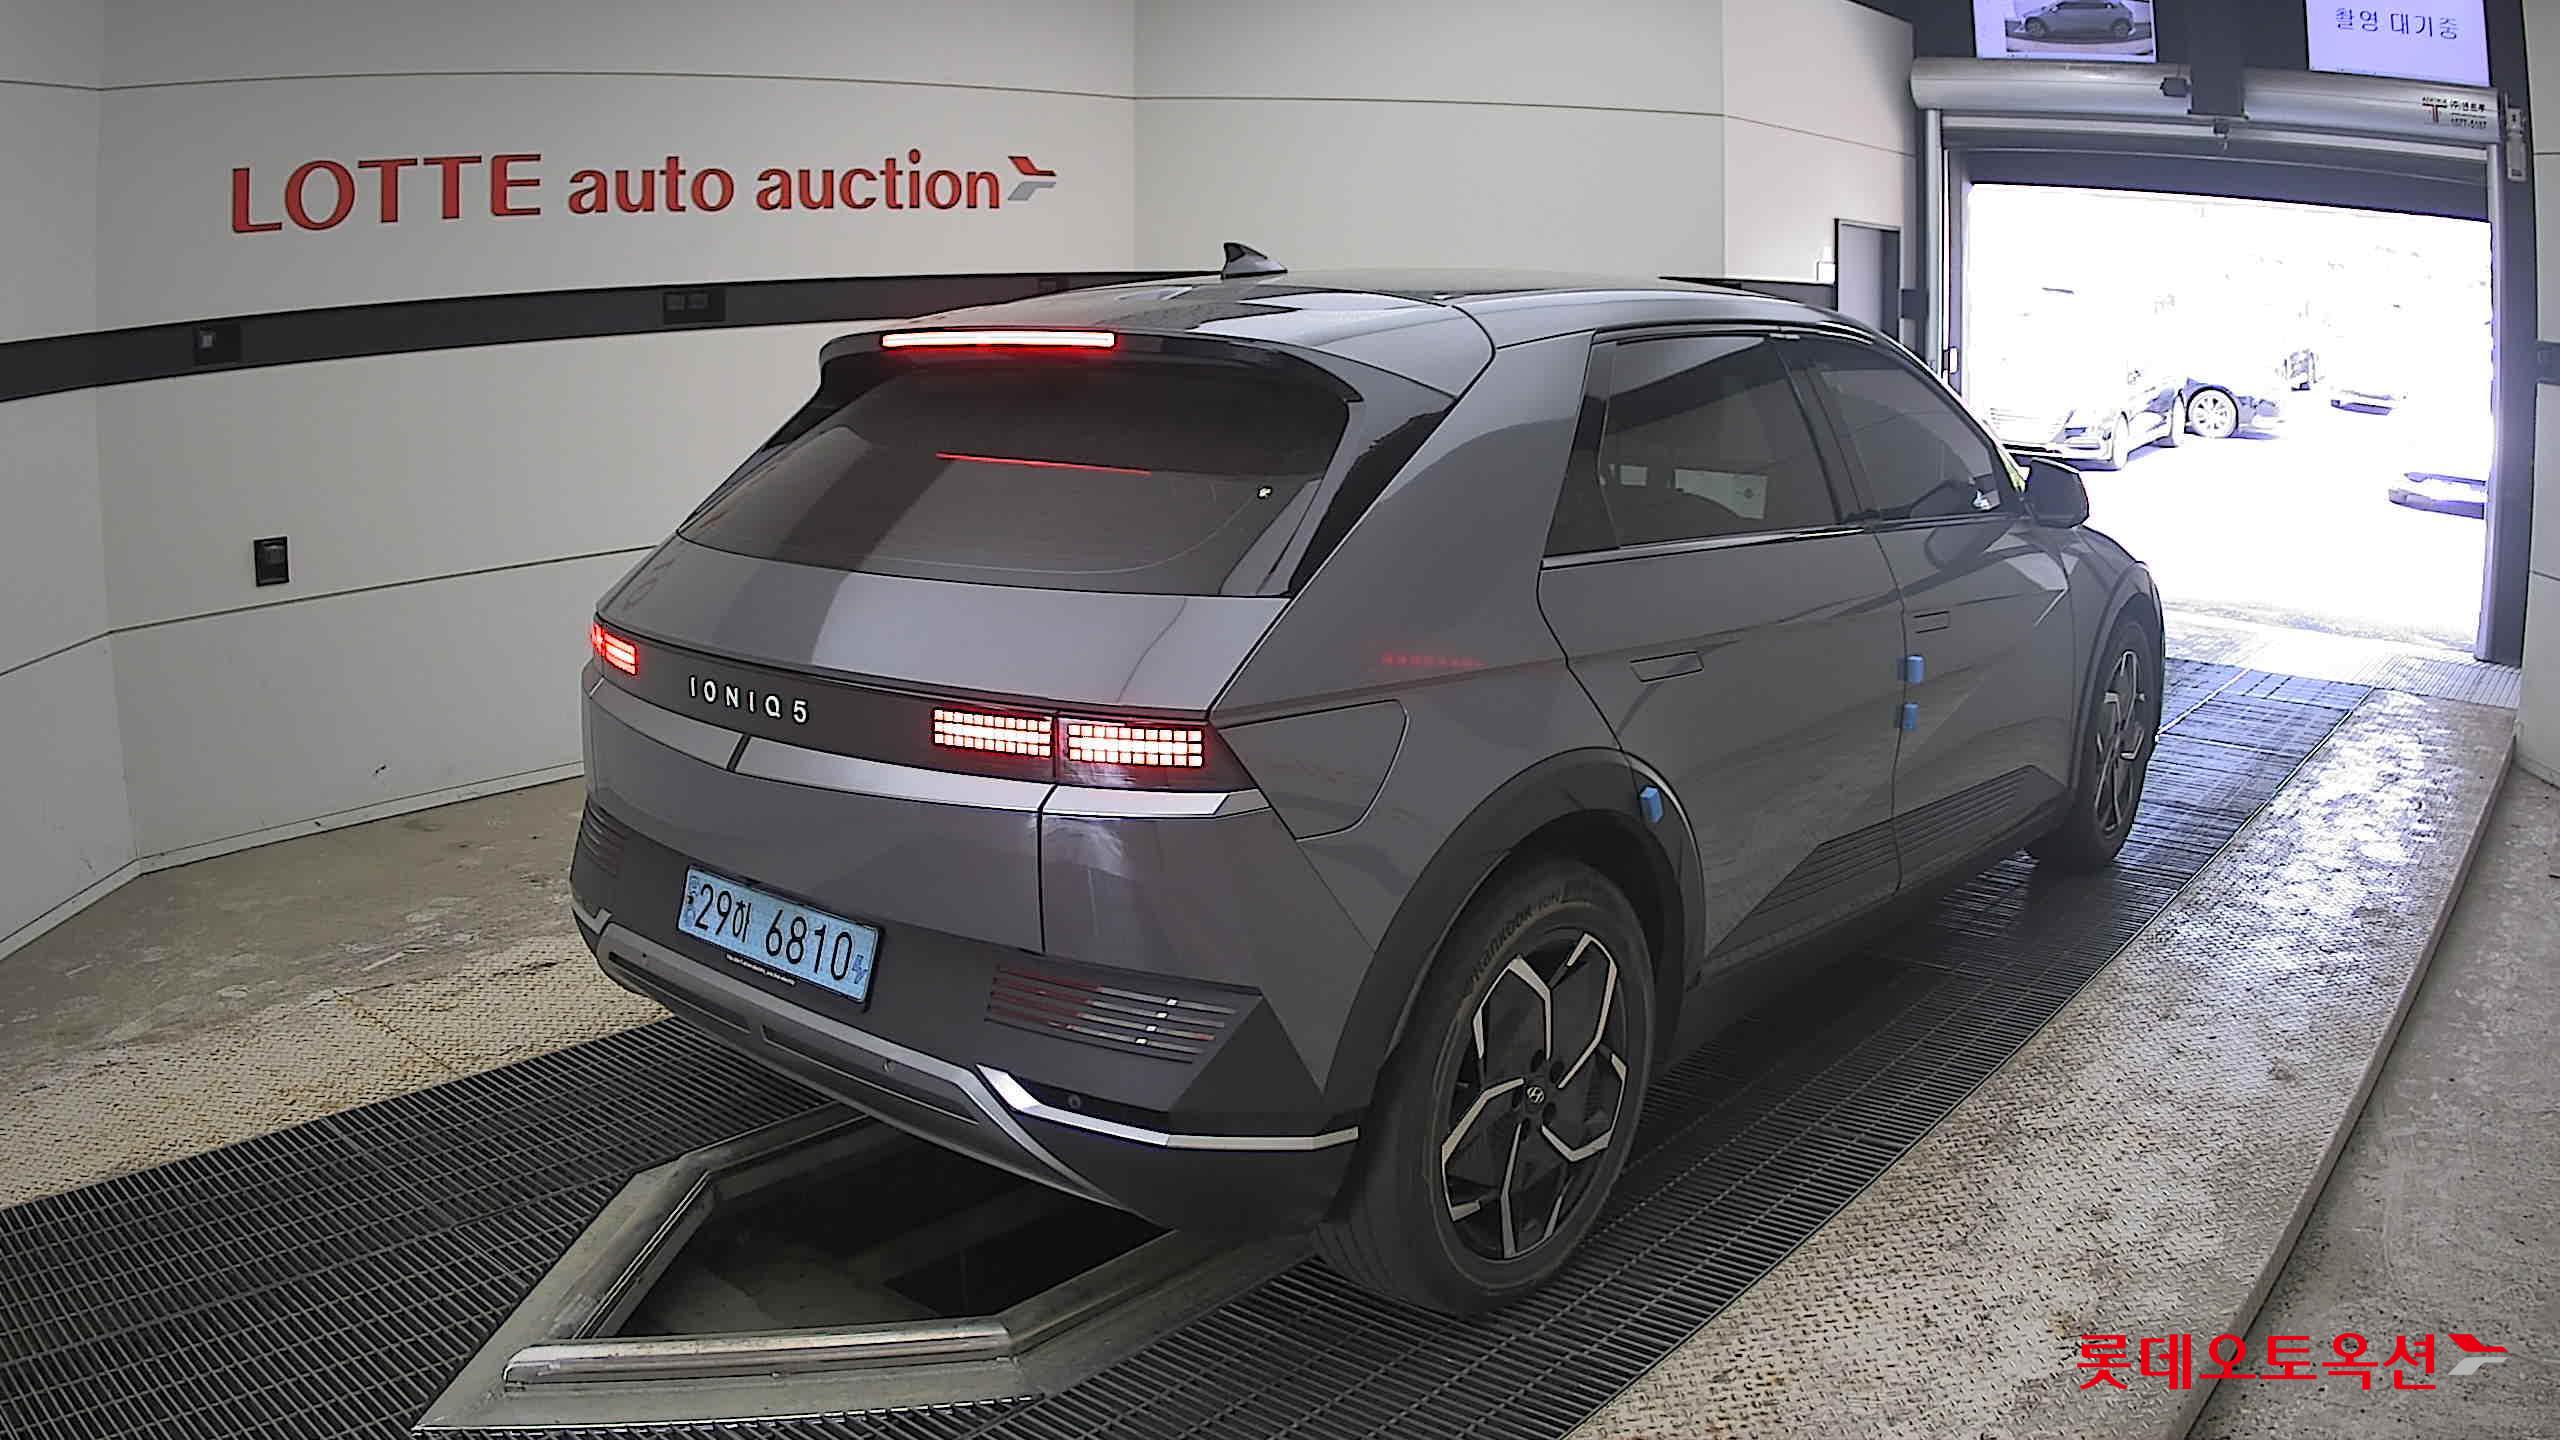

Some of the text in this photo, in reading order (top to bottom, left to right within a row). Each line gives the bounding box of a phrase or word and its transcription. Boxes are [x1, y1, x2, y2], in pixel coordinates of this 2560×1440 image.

[2389, 12, 2458, 40] 대기중
[232, 148, 1001, 234] LOTTE auto auction
[765, 909, 853, 981] 6810
